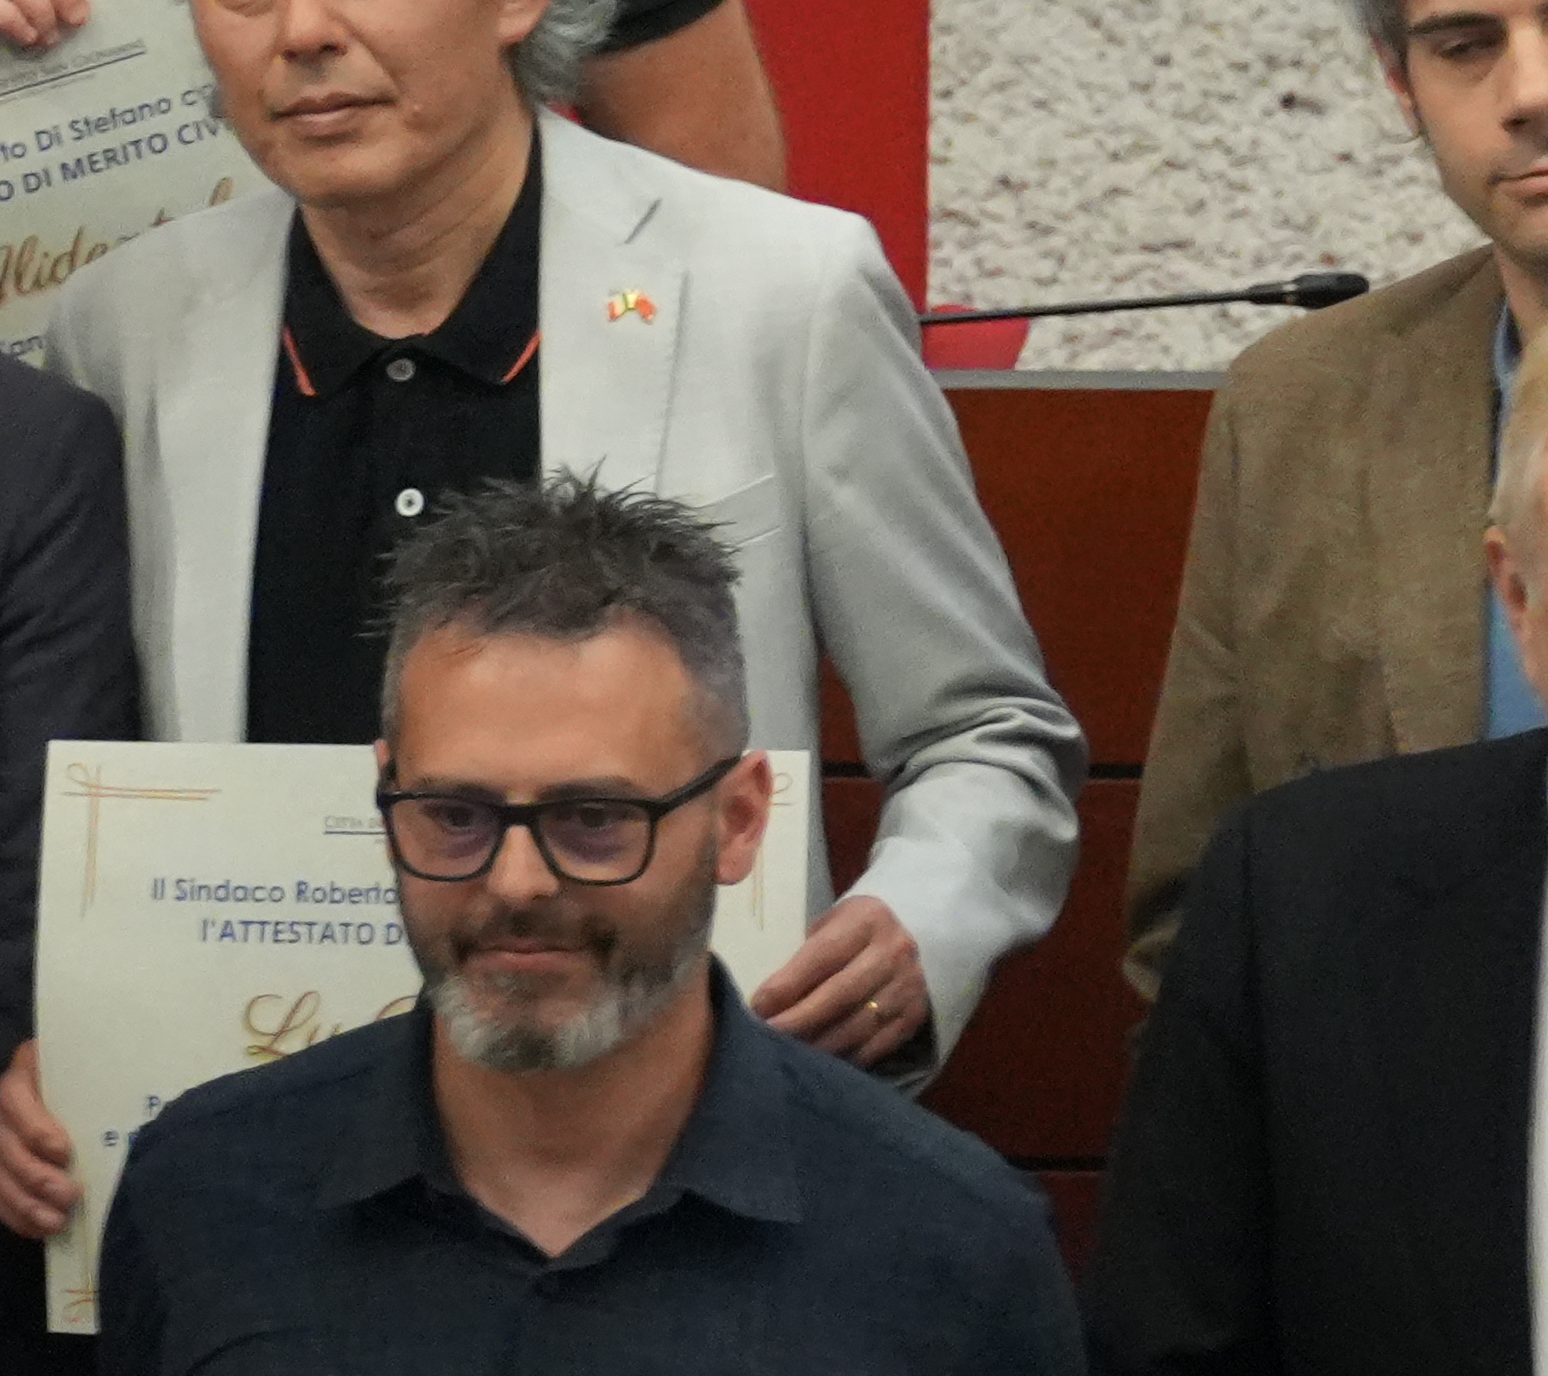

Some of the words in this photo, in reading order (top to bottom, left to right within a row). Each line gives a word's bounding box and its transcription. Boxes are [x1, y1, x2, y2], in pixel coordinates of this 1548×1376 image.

[35, 128, 64, 154] Di
[70, 96, 173, 143] Stefano
[22, 170, 53, 196] DI
[60, 133, 170, 183] MERITO
[177, 115, 226, 146] CIV
[151, 878, 165, 900] Il
[173, 878, 286, 904] Sindaco
[295, 879, 398, 906] Roberto
[202, 919, 375, 945] l'ATTESTATO
